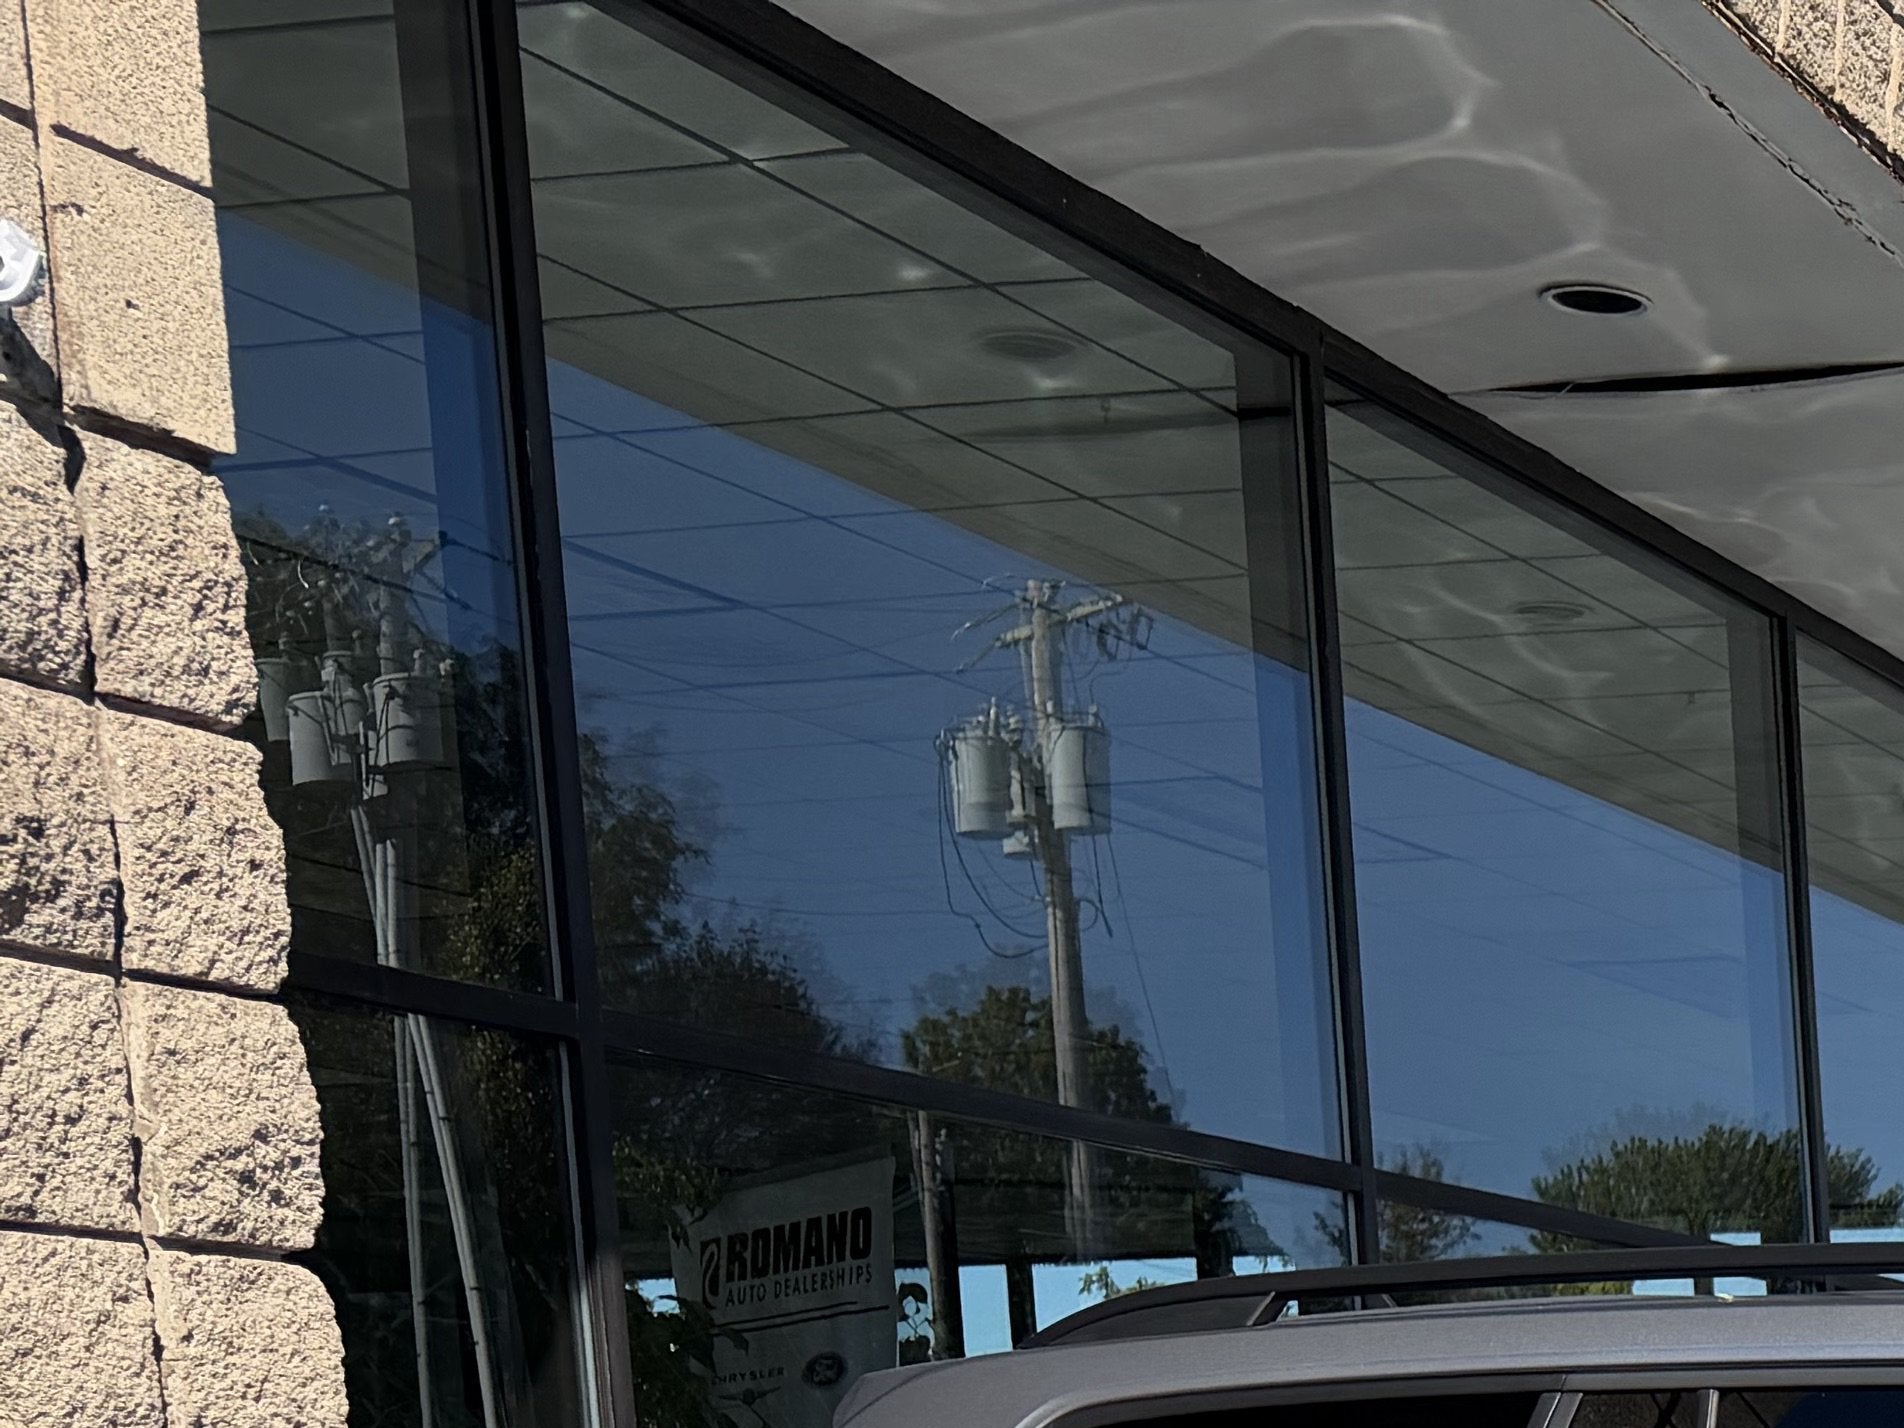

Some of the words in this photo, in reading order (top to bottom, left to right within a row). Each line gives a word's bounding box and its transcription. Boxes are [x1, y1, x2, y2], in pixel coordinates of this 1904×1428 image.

[726, 1206, 872, 1283] ROMANO
[725, 1284, 767, 1308] AUTO
[773, 1261, 873, 1300] DEALERSHIPS
